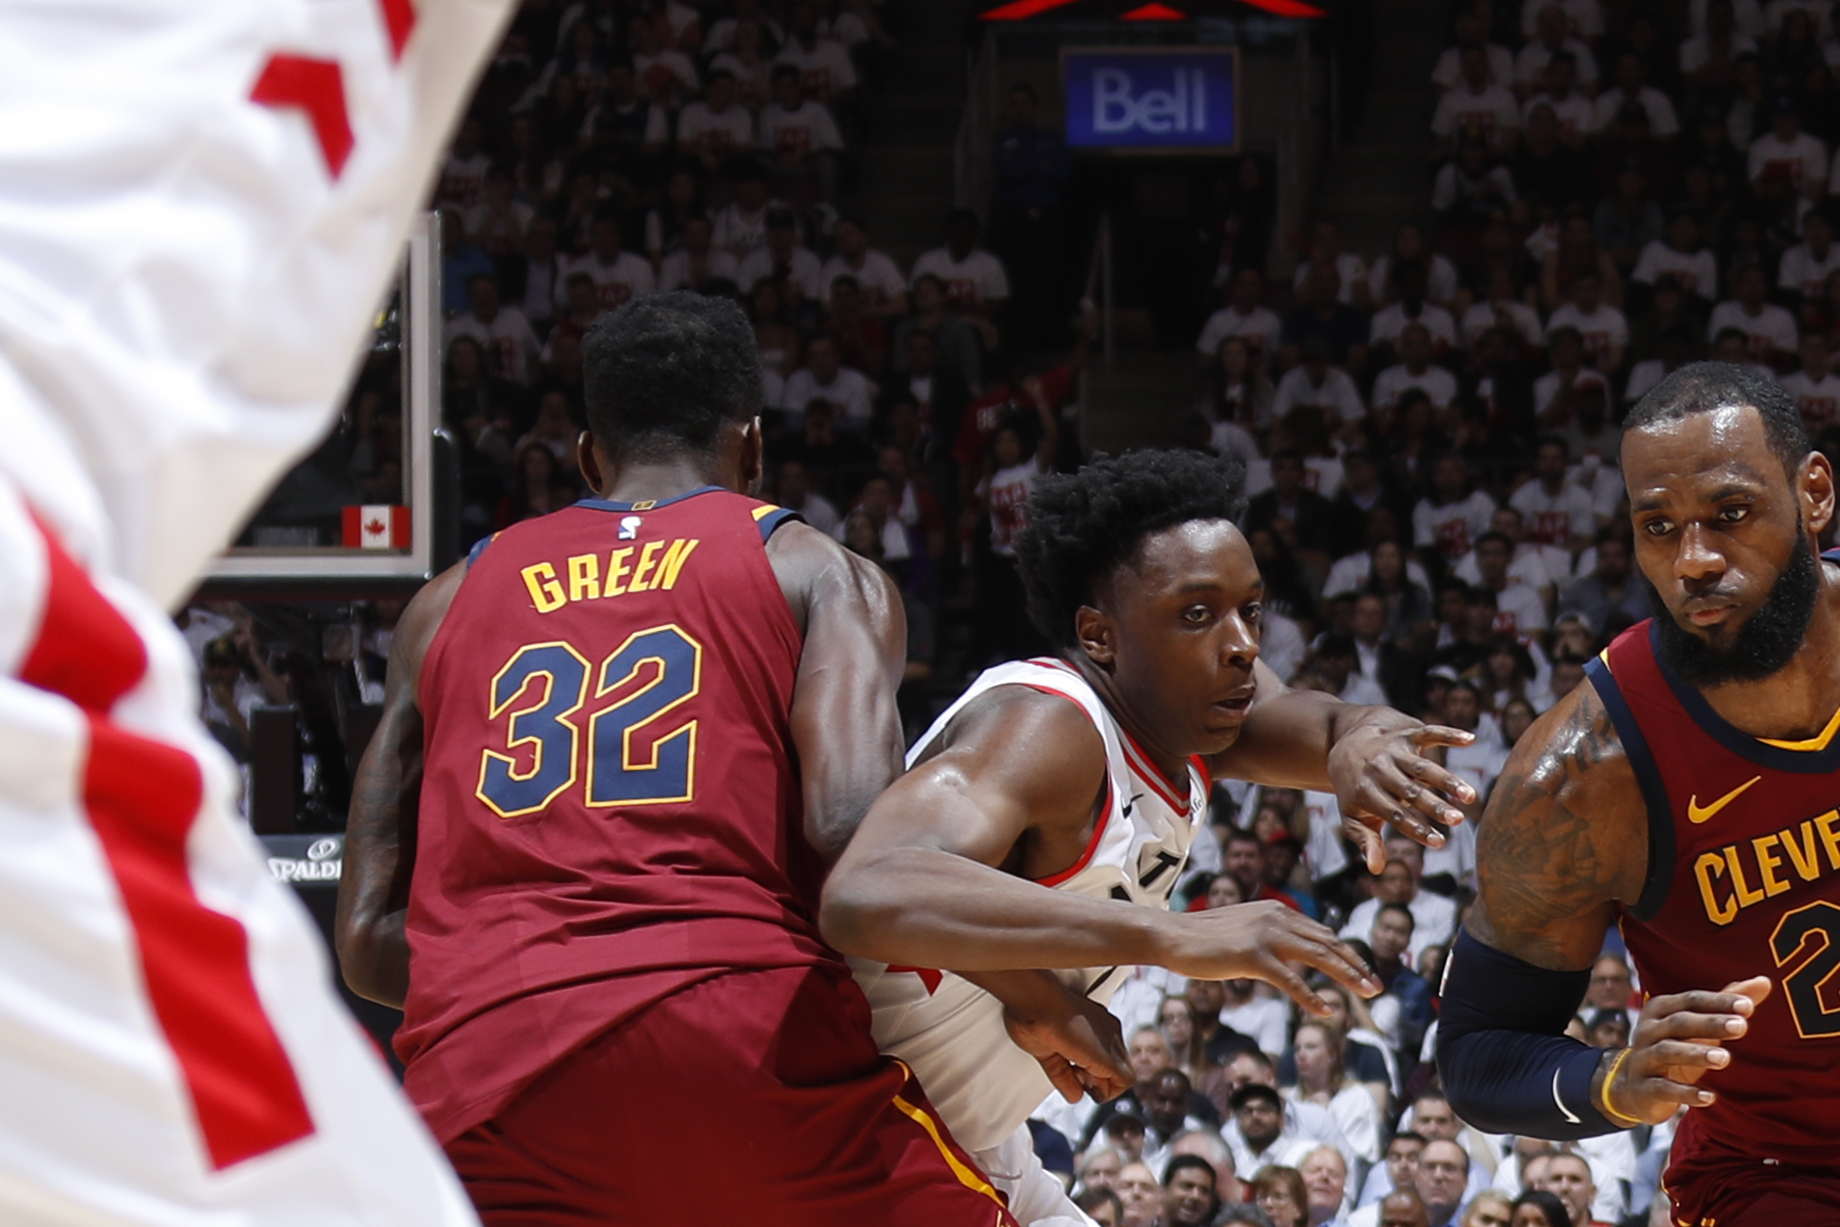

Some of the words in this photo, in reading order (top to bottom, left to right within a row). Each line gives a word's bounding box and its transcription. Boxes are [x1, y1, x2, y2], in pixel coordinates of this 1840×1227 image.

[1092, 66, 1206, 133] Bell
[520, 538, 700, 613] GREEN
[475, 623, 702, 818] 32
